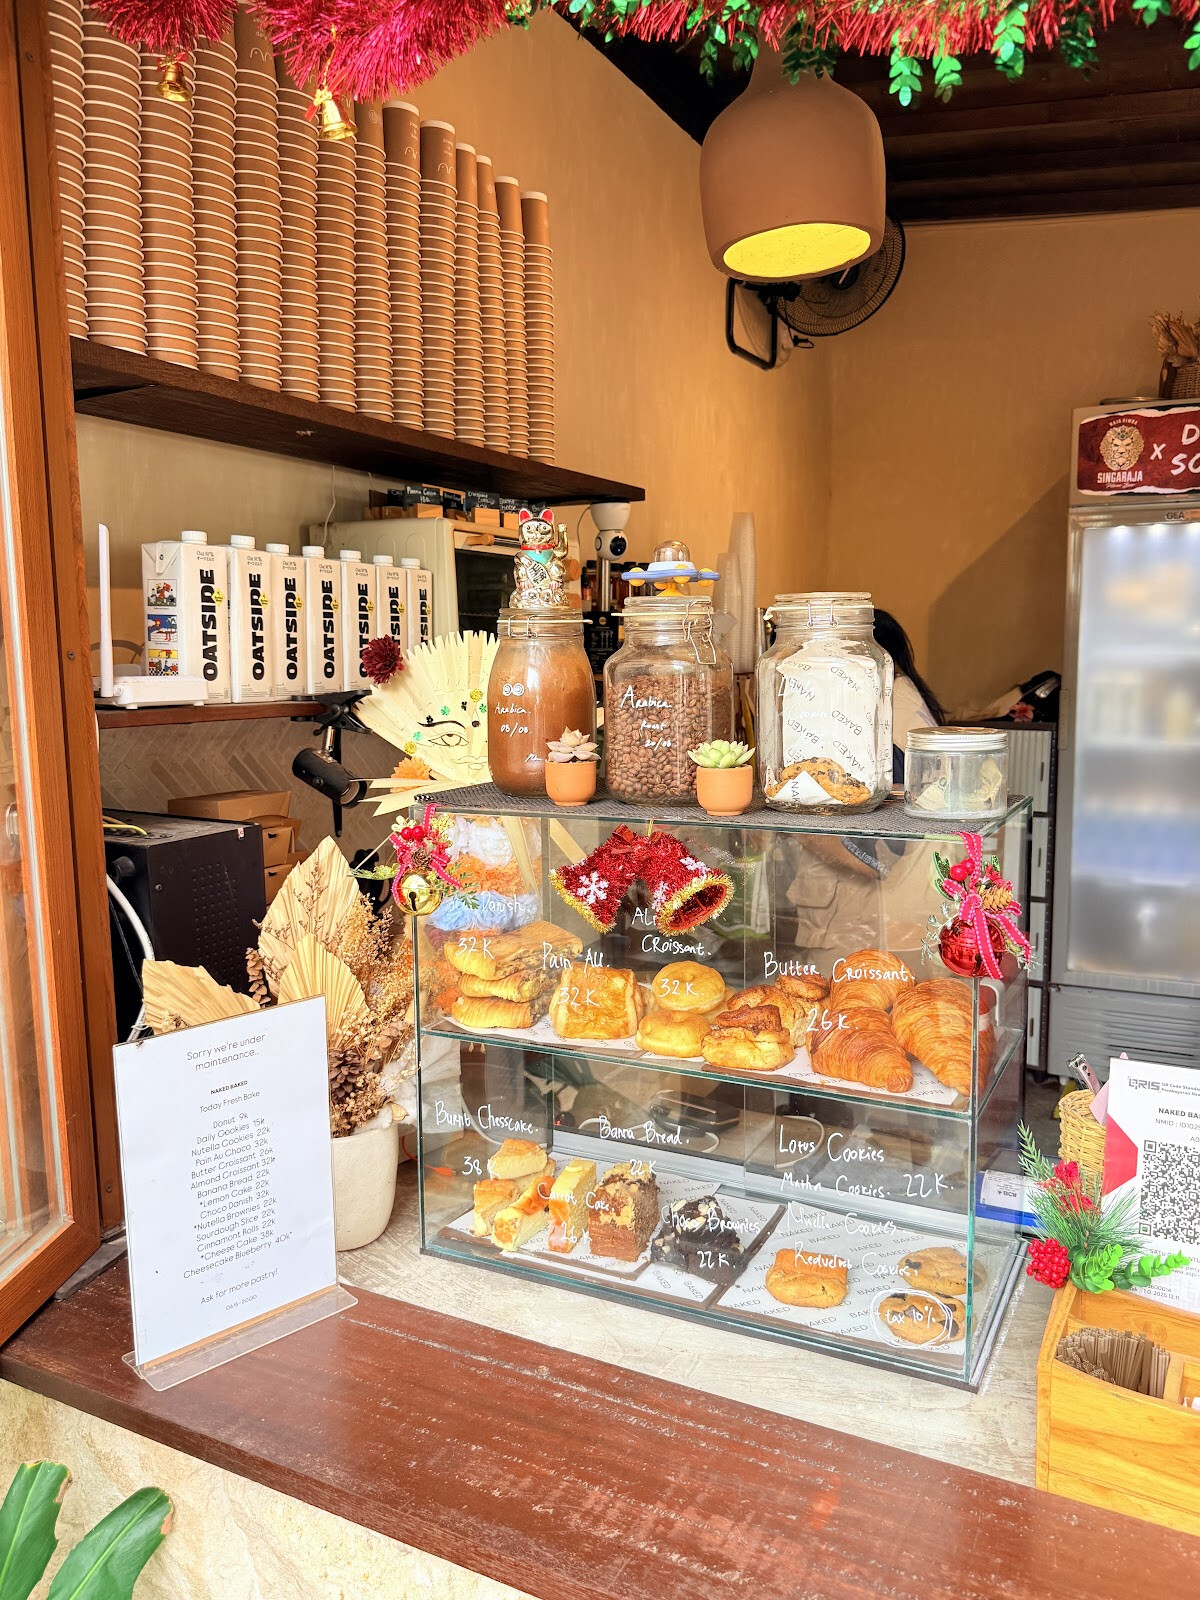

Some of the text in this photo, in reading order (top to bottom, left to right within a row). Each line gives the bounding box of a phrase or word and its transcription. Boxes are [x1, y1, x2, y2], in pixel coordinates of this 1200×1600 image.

[1097, 471, 1143, 484] SINGARAJA
[200, 569, 218, 682] OATSIDE
[248, 573, 265, 681] OATSIDE
[284, 577, 298, 680] OATSIDE
[321, 580, 335, 679] OATSIDE
[830, 666, 860, 692] NAKED
[831, 710, 863, 736] BAKED
[542, 941, 573, 970] Pain
[186, 1034, 266, 1061] Sorry we're under
[210, 1080, 248, 1095] NAKED BAKED
[1128, 1078, 1161, 1091] QRIS
[199, 1091, 261, 1114] Today Fresh Bake
[435, 1100, 471, 1128] Burnt
[1158, 1107, 1186, 1117] NAKED
[197, 1118, 265, 1145] Daily Cookies 15k
[213, 1112, 249, 1129] Donut 9k
[1155, 1118, 1174, 1127] NMID
[191, 1126, 271, 1158] Nutella Cookies 22k
[195, 1137, 269, 1167] Pain Au Choco 32k
[779, 1124, 885, 1162] Lotus Cookies
[191, 1147, 274, 1180] Butter Croissant 26k
[191, 1174, 221, 1190] Almond
[222, 1162, 260, 1179] Croissant
[197, 1168, 271, 1199] Banana Bread 22k
[231, 1186, 252, 1198] Cake
[255, 1179, 270, 1190] 22k
[200, 1190, 270, 1219] Choco Danish 32k
[227, 1203, 261, 1221] Brownies
[263, 1197, 277, 1208] 22k
[196, 1208, 276, 1242] Sourdough Slice 22k
[242, 1224, 259, 1236] Rolls
[262, 1218, 276, 1229] 22k
[236, 1236, 258, 1249] Cake
[260, 1229, 274, 1240] 38k
[183, 1255, 234, 1279] Cheesecake
[235, 1241, 272, 1259] Blueberry
[200, 1268, 278, 1305] Ask for more pastry!
[856, 1285, 891, 1296] BAKED
[885, 1309, 905, 1325] tax
